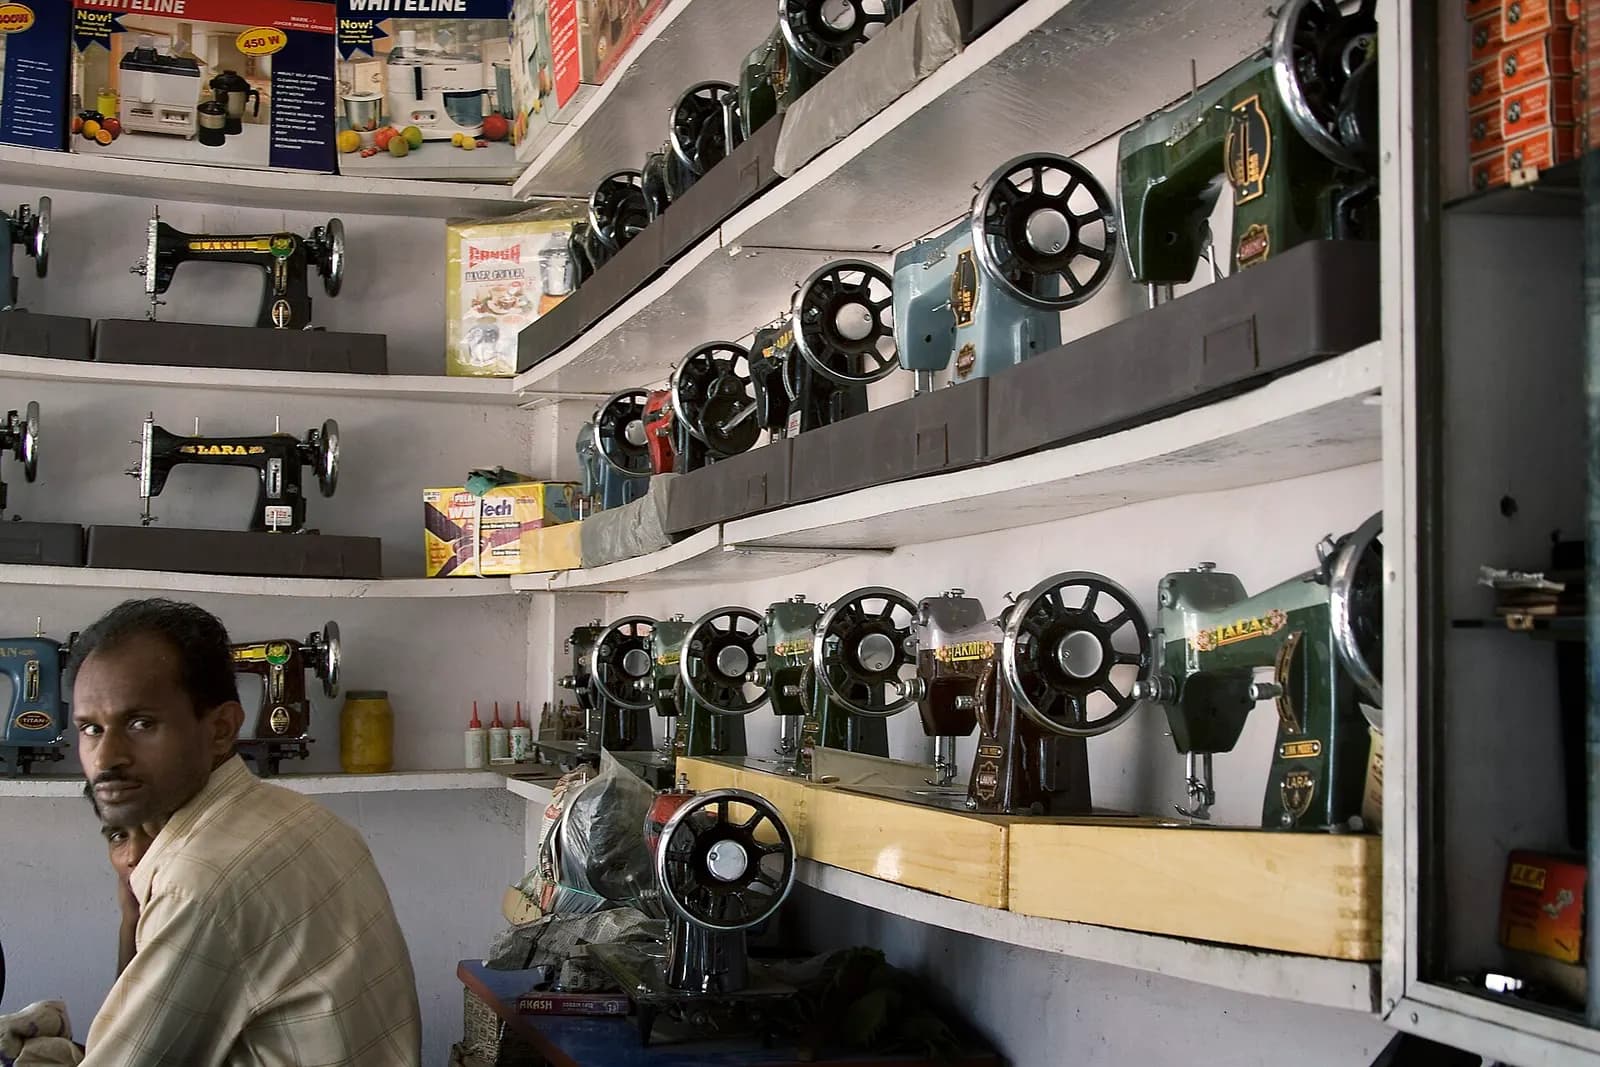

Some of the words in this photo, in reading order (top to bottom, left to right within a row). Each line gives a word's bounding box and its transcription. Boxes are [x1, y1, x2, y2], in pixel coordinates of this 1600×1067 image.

[349, 0, 466, 12] WHITELINE
[0, 14, 28, 23] 00W
[77, 10, 113, 23] Now!
[340, 19, 374, 29] Now!
[244, 37, 265, 48] 450
[268, 35, 280, 45] W
[197, 444, 248, 456] LARA
[519, 1000, 553, 1011] AKASH
